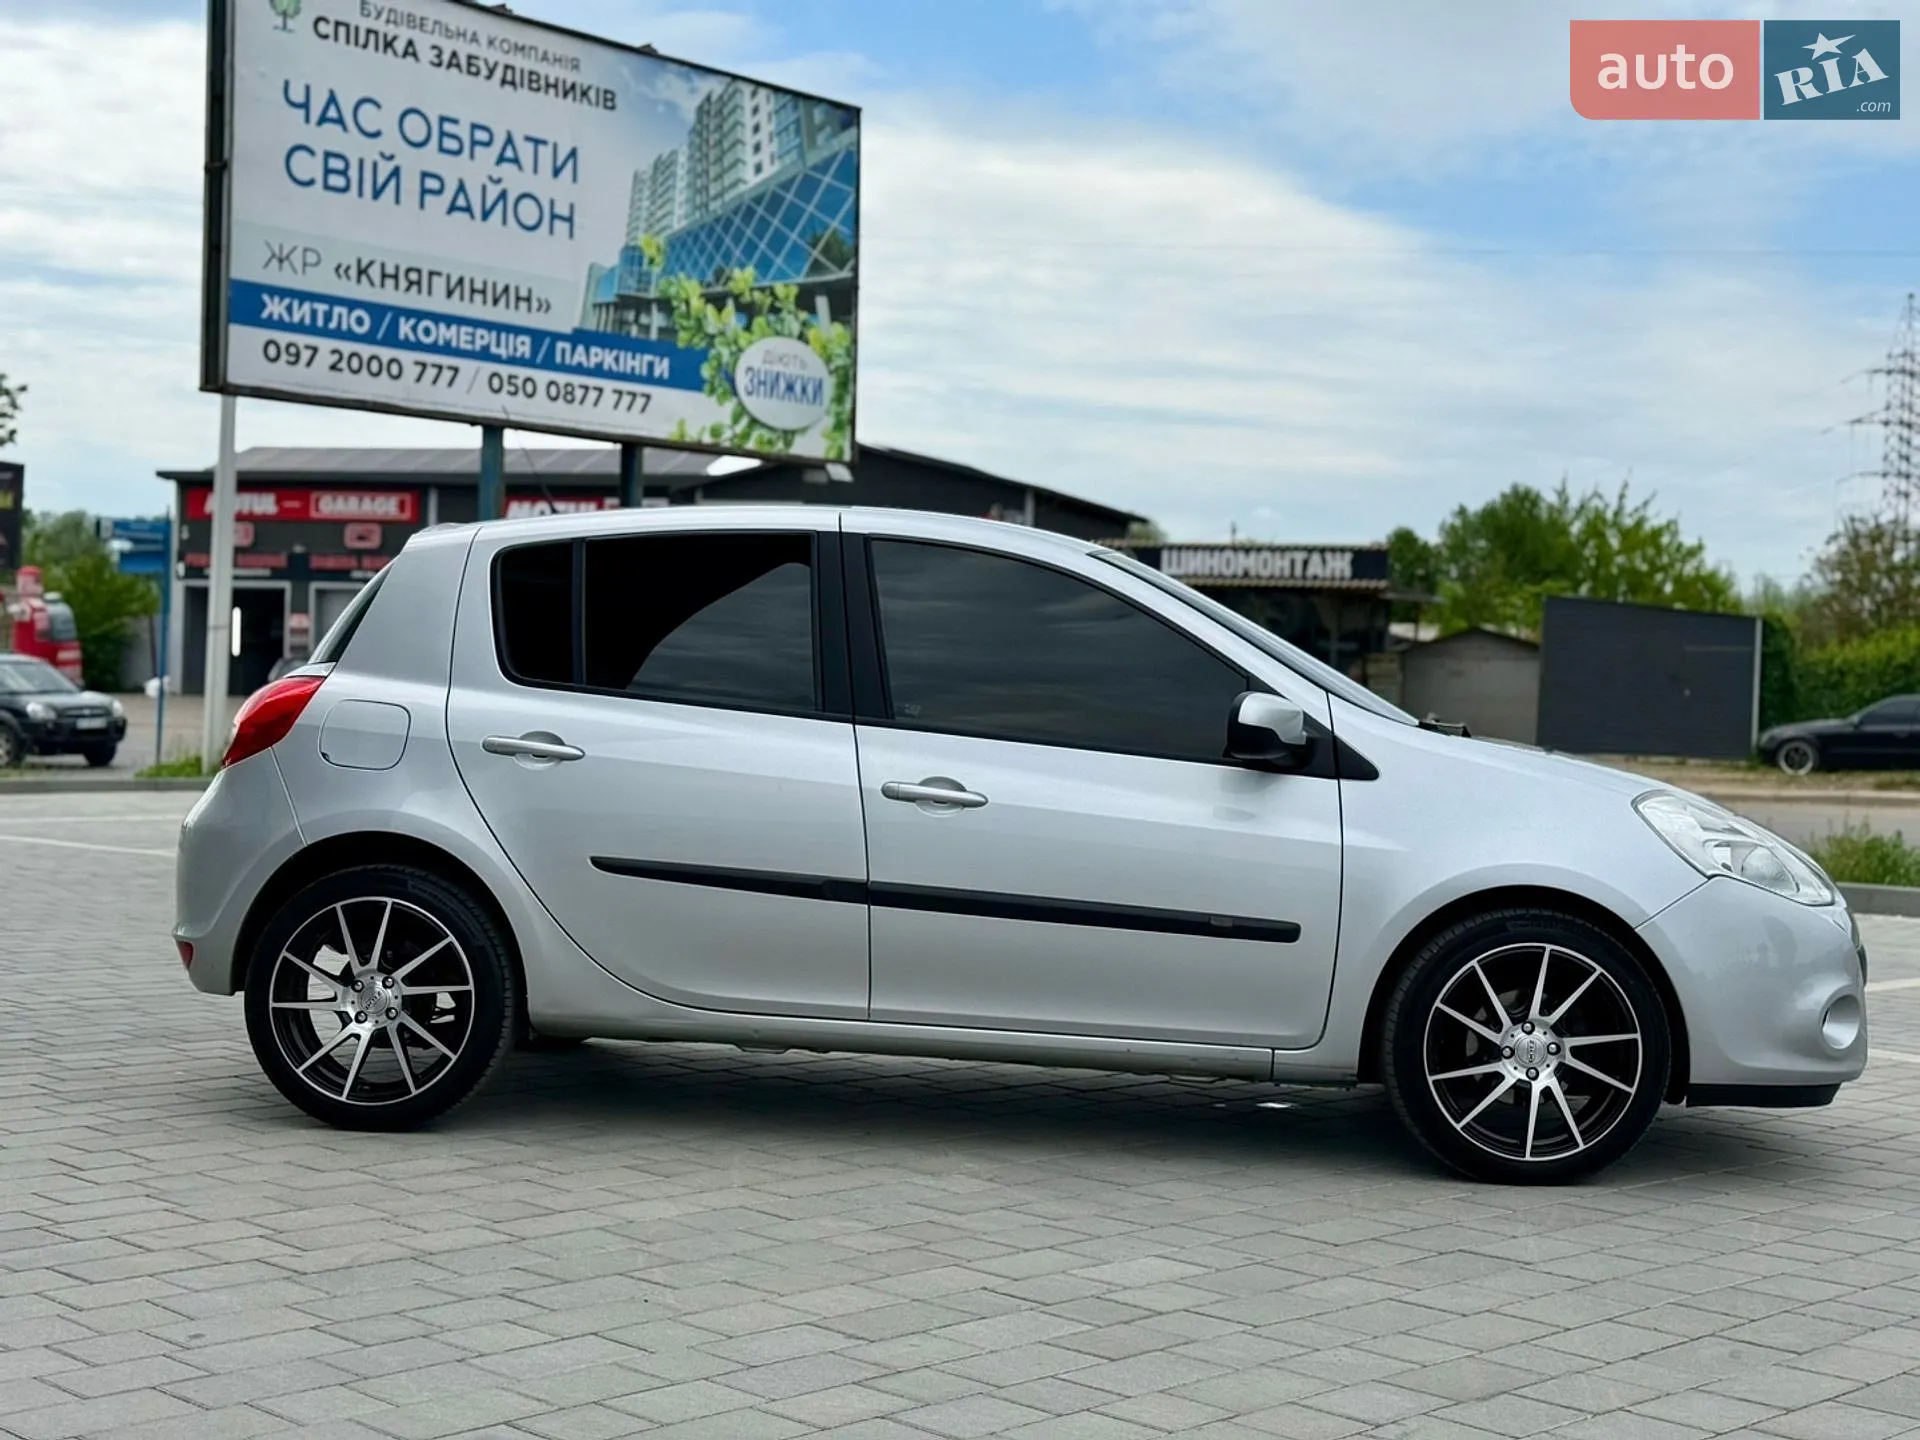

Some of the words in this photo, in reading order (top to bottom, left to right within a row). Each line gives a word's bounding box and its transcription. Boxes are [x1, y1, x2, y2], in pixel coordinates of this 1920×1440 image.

[312, 16, 420, 64] СПІЛКА
[428, 45, 618, 111] ЗАБУДІВНИКІВ
[359, 1, 480, 47] БУДІВЕЛЬНА
[487, 35, 581, 73] КОМПАНІЯ
[282, 79, 383, 139] ЧАС
[398, 107, 579, 184] ОБРАТИ
[284, 144, 402, 206] СВІЙ
[418, 170, 575, 239] РАЙОН
[261, 240, 322, 276] ЖР
[334, 257, 552, 315] «КНЯГИНИН»
[260, 293, 371, 335] ЖИТЛО
[398, 316, 531, 361] КОМЕРЦІЯ
[555, 341, 670, 380] ПАРКІНГИ
[263, 339, 319, 368] 097
[328, 349, 404, 381] 2000
[413, 361, 460, 388] 777
[488, 371, 537, 398] 050
[546, 380, 604, 408] 0877
[612, 388, 652, 414] 777
[744, 366, 824, 407] ЗНИЖКИ
[318, 496, 399, 514] GARAGE
[1160, 549, 1353, 578] ШИНОМОНТАЖ
